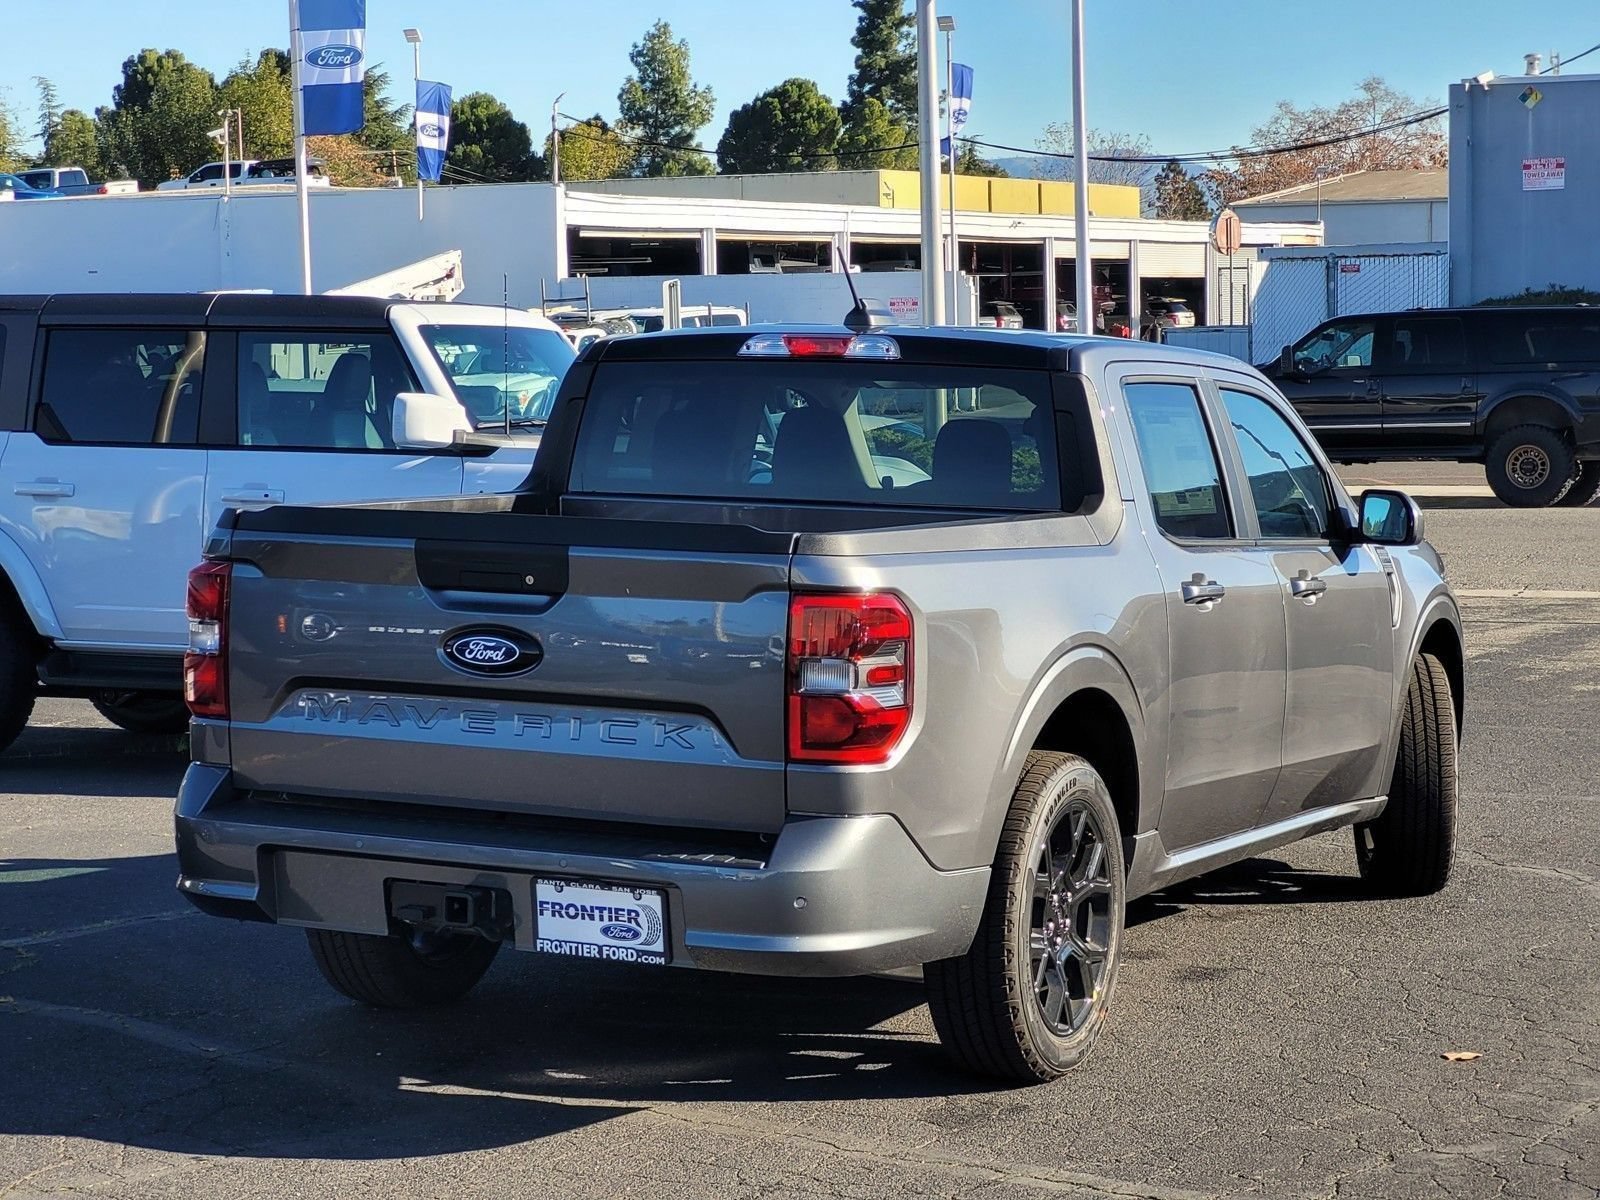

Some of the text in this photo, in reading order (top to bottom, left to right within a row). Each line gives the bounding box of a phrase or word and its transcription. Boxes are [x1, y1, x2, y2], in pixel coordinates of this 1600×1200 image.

[318, 48, 354, 65] Ford
[465, 640, 507, 661] Ford
[304, 697, 696, 750] MAVERICK
[537, 879, 566, 888] SANTA
[570, 882, 601, 891] CLARA
[538, 901, 644, 931] FRONTIER
[607, 926, 634, 939] Ford
[537, 939, 600, 958] FRONTIER
